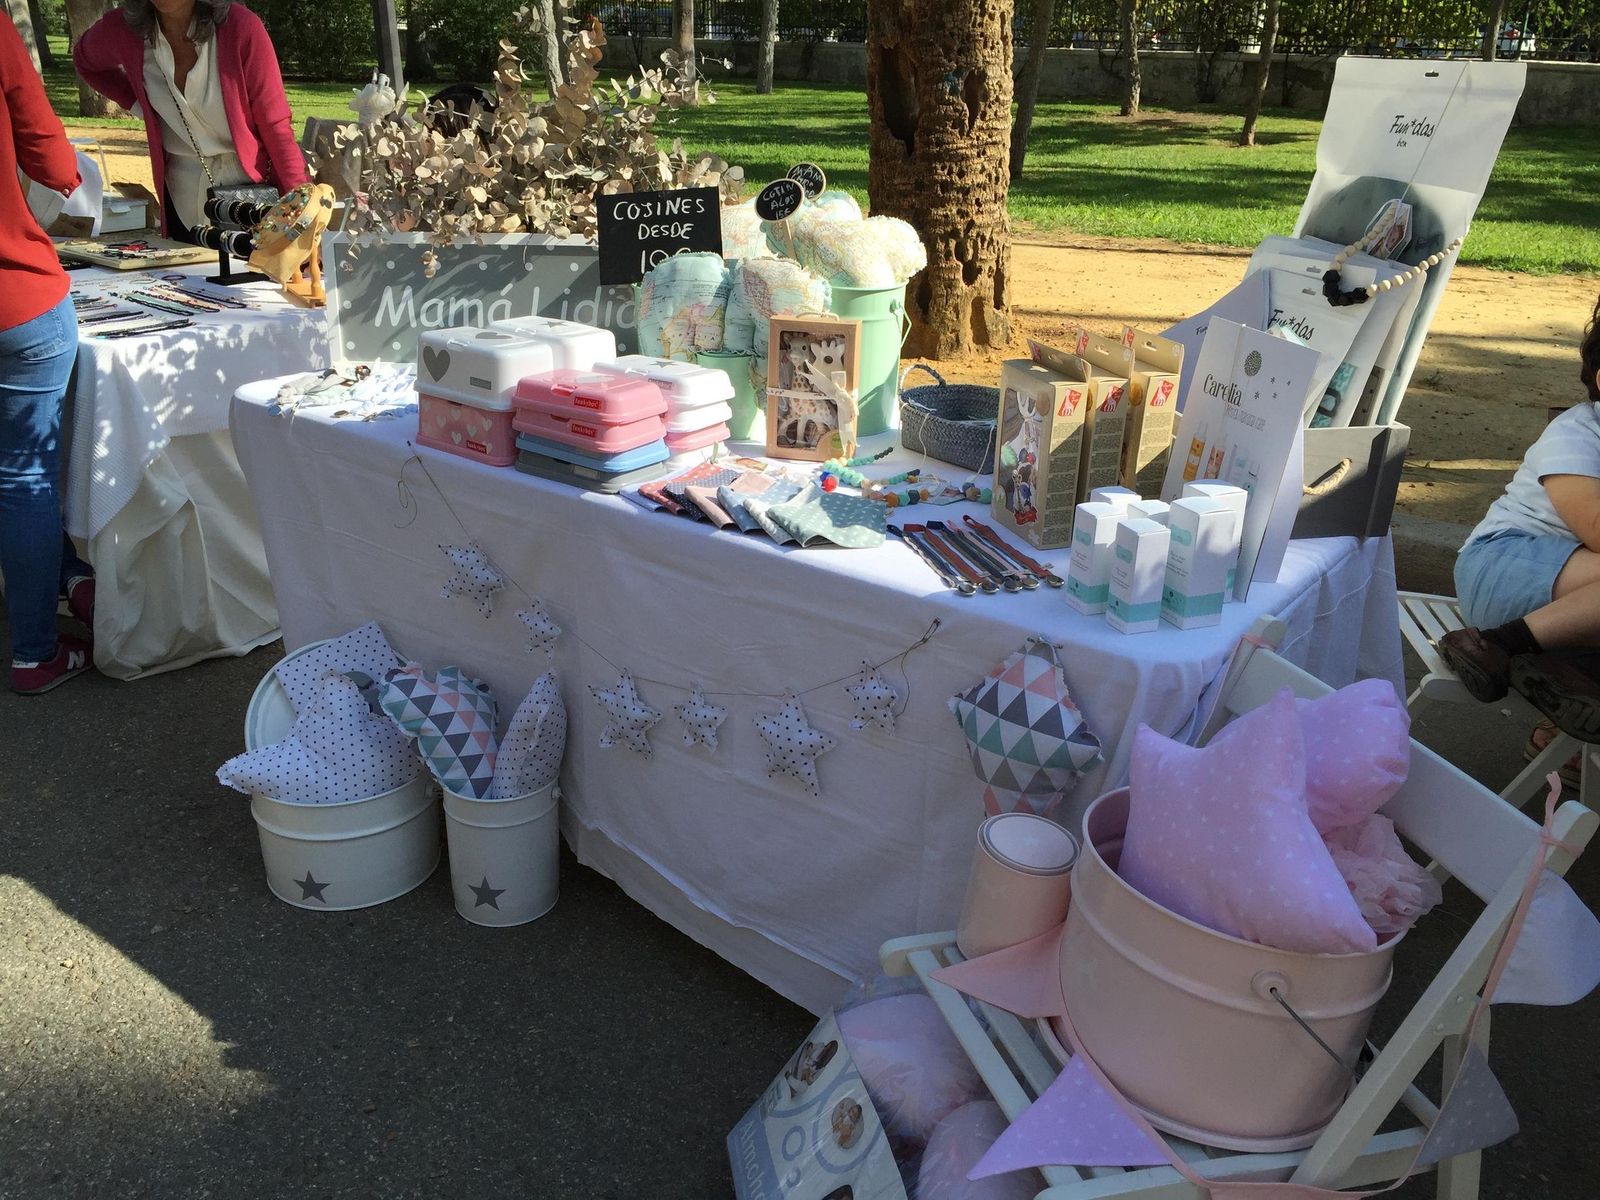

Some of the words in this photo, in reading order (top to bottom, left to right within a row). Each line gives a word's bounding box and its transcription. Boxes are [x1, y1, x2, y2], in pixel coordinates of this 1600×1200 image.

[613, 197, 705, 221] COJINES
[638, 222, 694, 240] DESDE
[640, 247, 692, 275] 10
[374, 283, 513, 328] Mamá
[1203, 373, 1242, 407] Carelia
